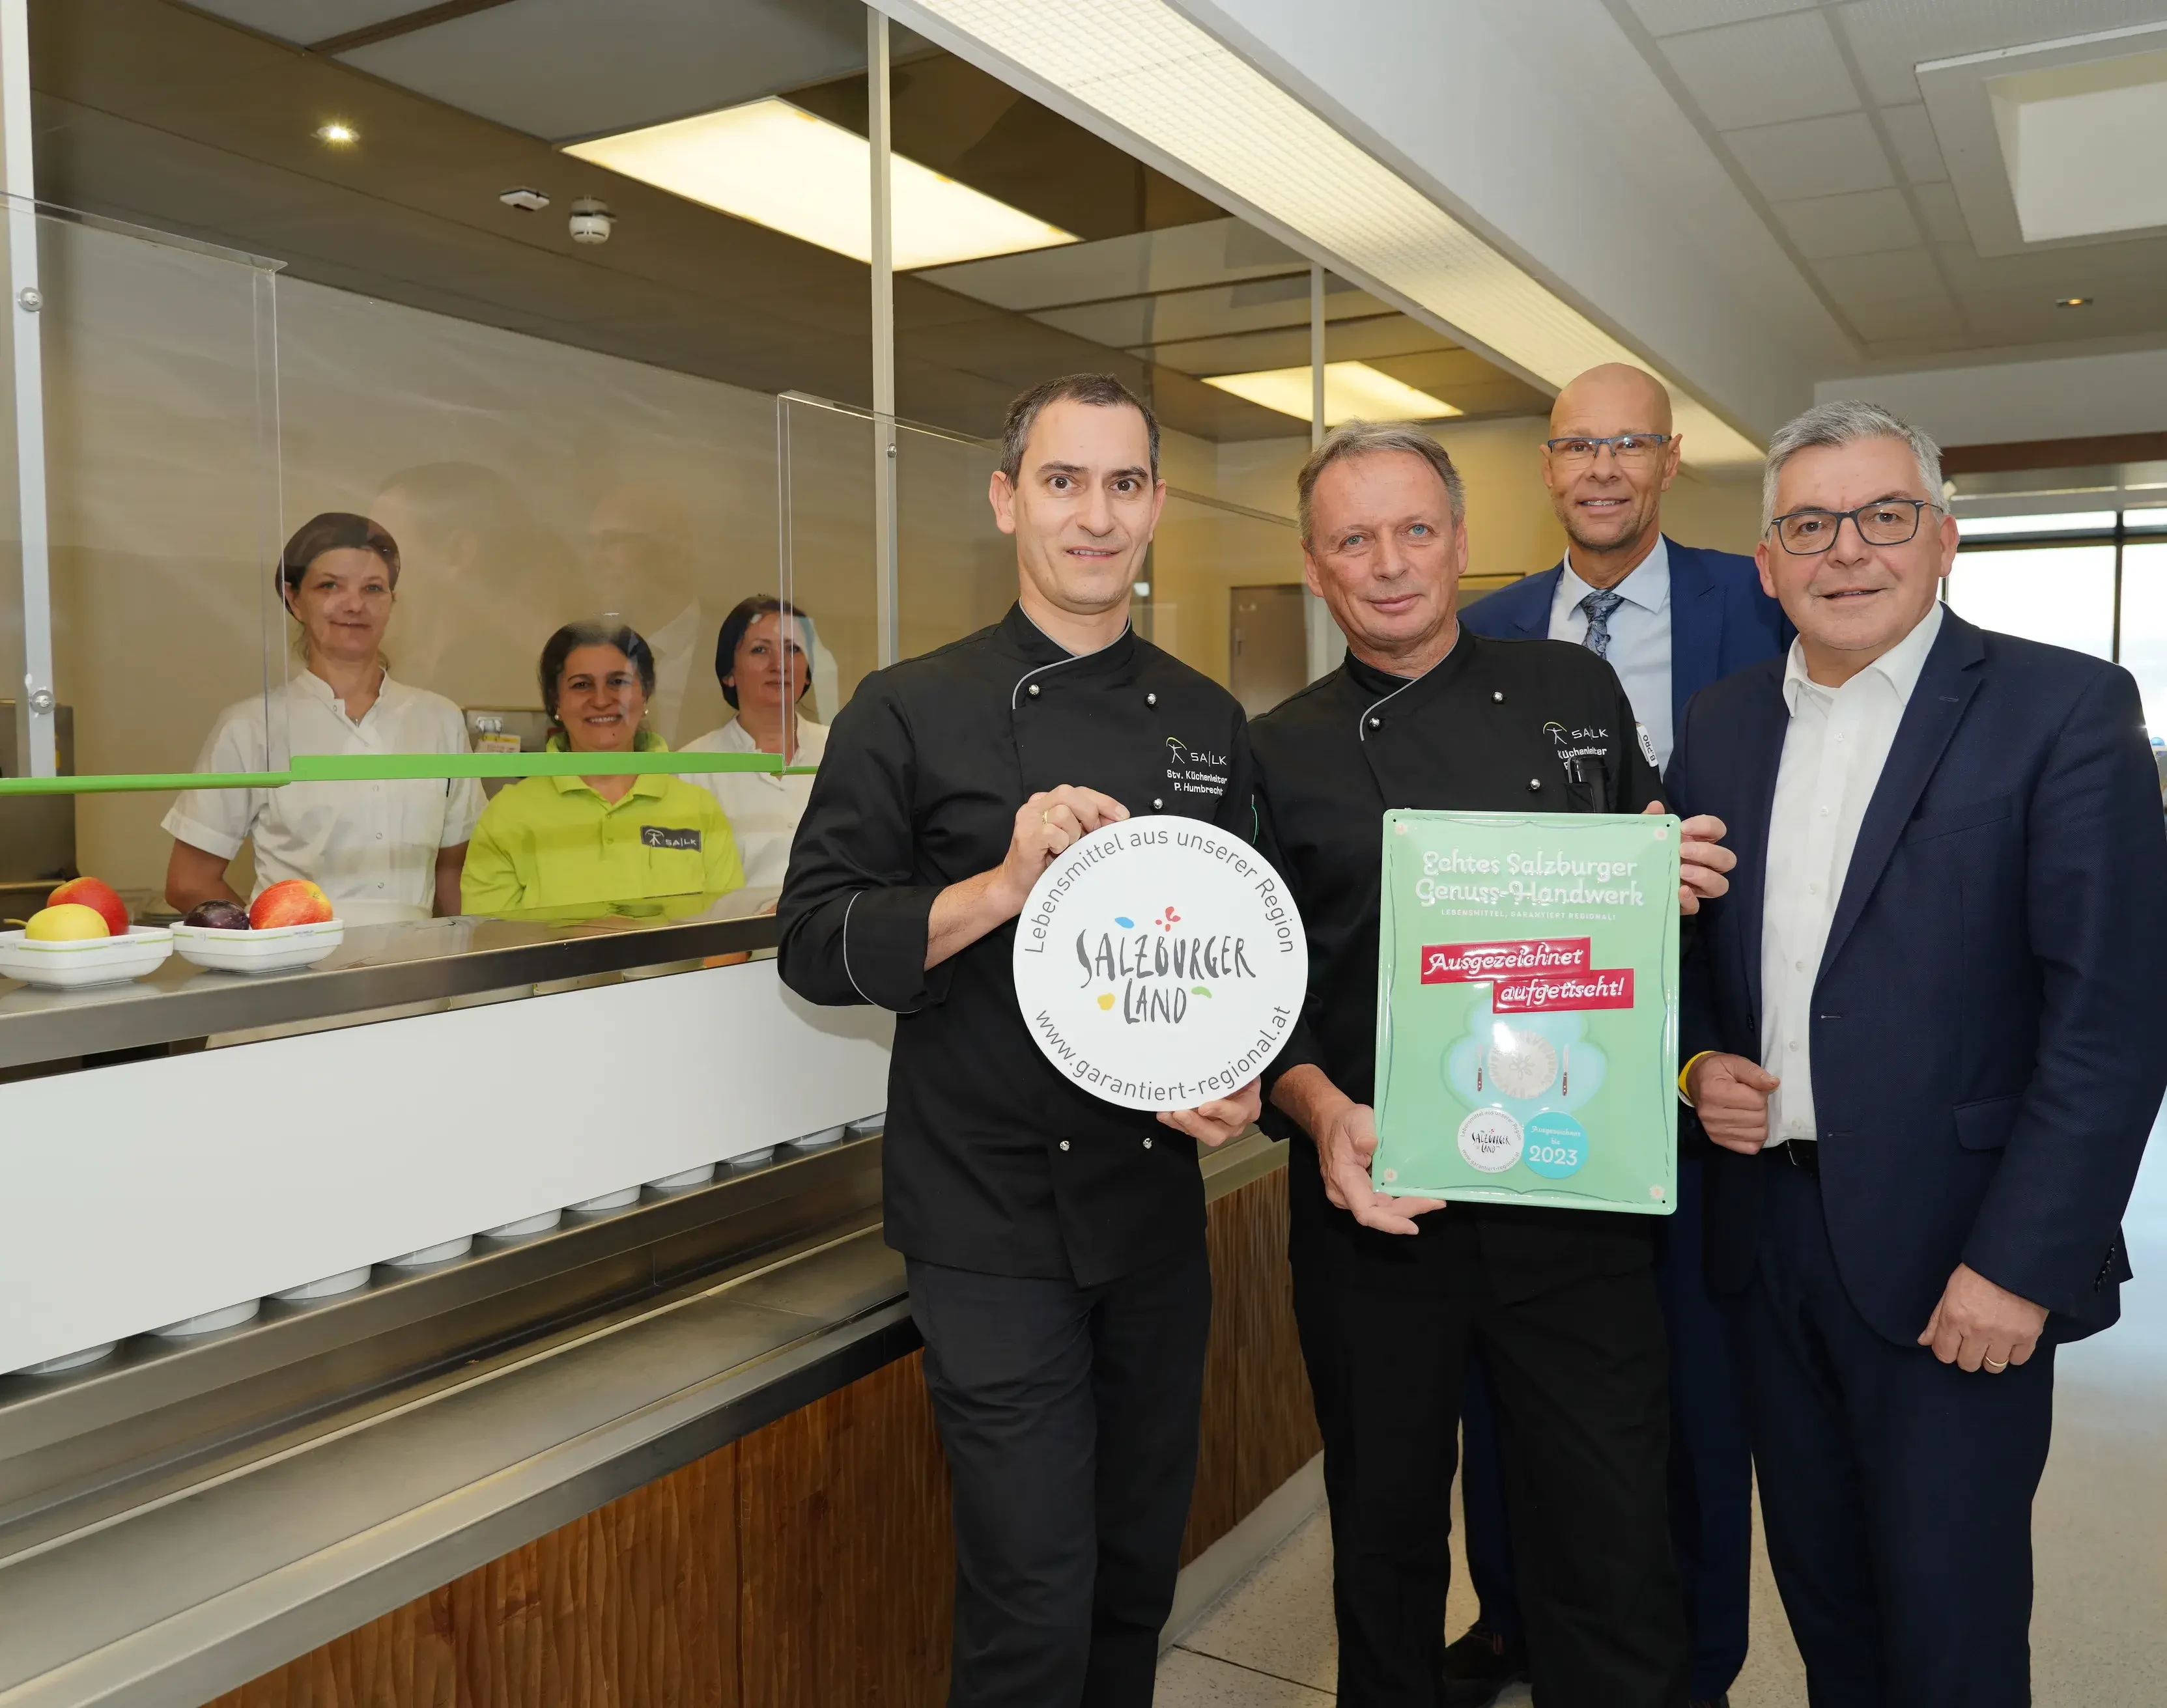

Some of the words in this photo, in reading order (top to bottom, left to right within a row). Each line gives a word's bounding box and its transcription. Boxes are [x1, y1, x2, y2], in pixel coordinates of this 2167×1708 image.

[1557, 746, 1608, 759] Küchenleiter
[1643, 735, 1656, 761] B.PRO
[1167, 769, 1183, 779] Stv.
[1185, 770, 1228, 784] Küchenleiter
[1174, 782, 1182, 791] P.
[1183, 783, 1223, 796] Humbrecht
[1423, 847, 1501, 876] Echtes
[1507, 847, 1639, 883] Salzburger
[1025, 833, 1125, 953] Lebensmittel
[1130, 829, 1168, 848] aus
[1177, 831, 1258, 878] unserer
[1254, 878, 1294, 953] Region
[1415, 878, 1645, 908] Genuss-Handwerk
[1441, 909, 1508, 919] LEBENSMITTEL,
[1510, 911, 1566, 919] GARANTIERT
[1568, 913, 1616, 921] REGIONAL!
[1076, 929, 1256, 988] SALZBURGER
[1423, 942, 1584, 975] Ausgezeichnet
[1124, 978, 1187, 1024] LAND
[1500, 975, 1625, 1006] aufgetischt!
[1036, 1005, 1291, 1102] www.garantiert-regional.at
[1461, 1110, 1484, 1137] Lebensmittel
[1495, 1111, 1514, 1123] unserer
[1512, 1123, 1522, 1141] Region
[1471, 1132, 1511, 1146] SALZBURGER
[1532, 1125, 1581, 1137] Ausgezeichnet
[1481, 1144, 1496, 1153] LAND
[1529, 1145, 1578, 1166] 2023
